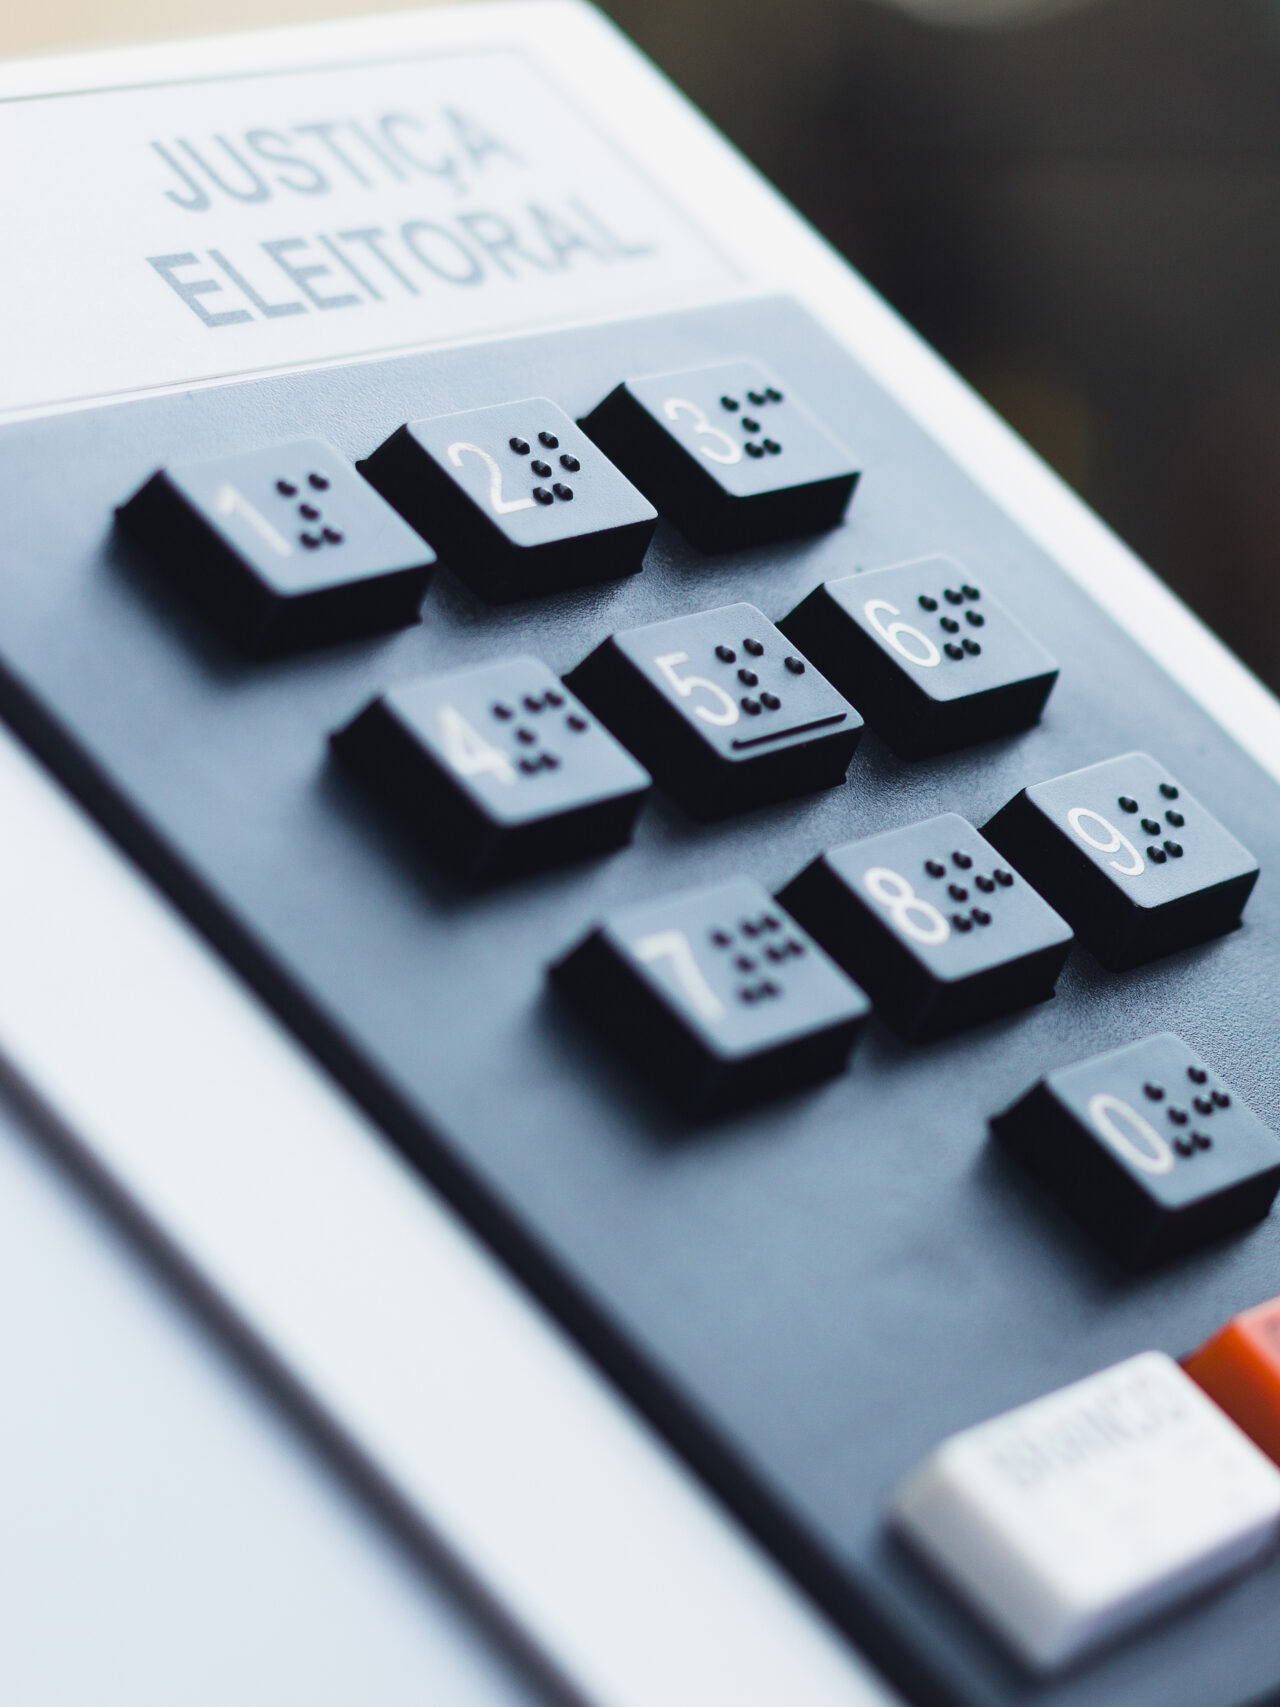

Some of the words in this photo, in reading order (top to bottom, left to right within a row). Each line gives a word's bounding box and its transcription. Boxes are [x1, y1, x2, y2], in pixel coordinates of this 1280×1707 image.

[147, 104, 528, 212] JUSTIÇA
[145, 196, 655, 329] ELEITORAL
[663, 398, 743, 466] 3
[447, 441, 538, 516] 2
[217, 482, 292, 559] 1
[863, 598, 942, 668] 6
[653, 651, 740, 727] 5
[437, 704, 518, 786] 4
[1067, 807, 1145, 876] 9
[863, 867, 951, 945] 8
[634, 929, 725, 1024] 7
[1088, 1093, 1174, 1175] 0
